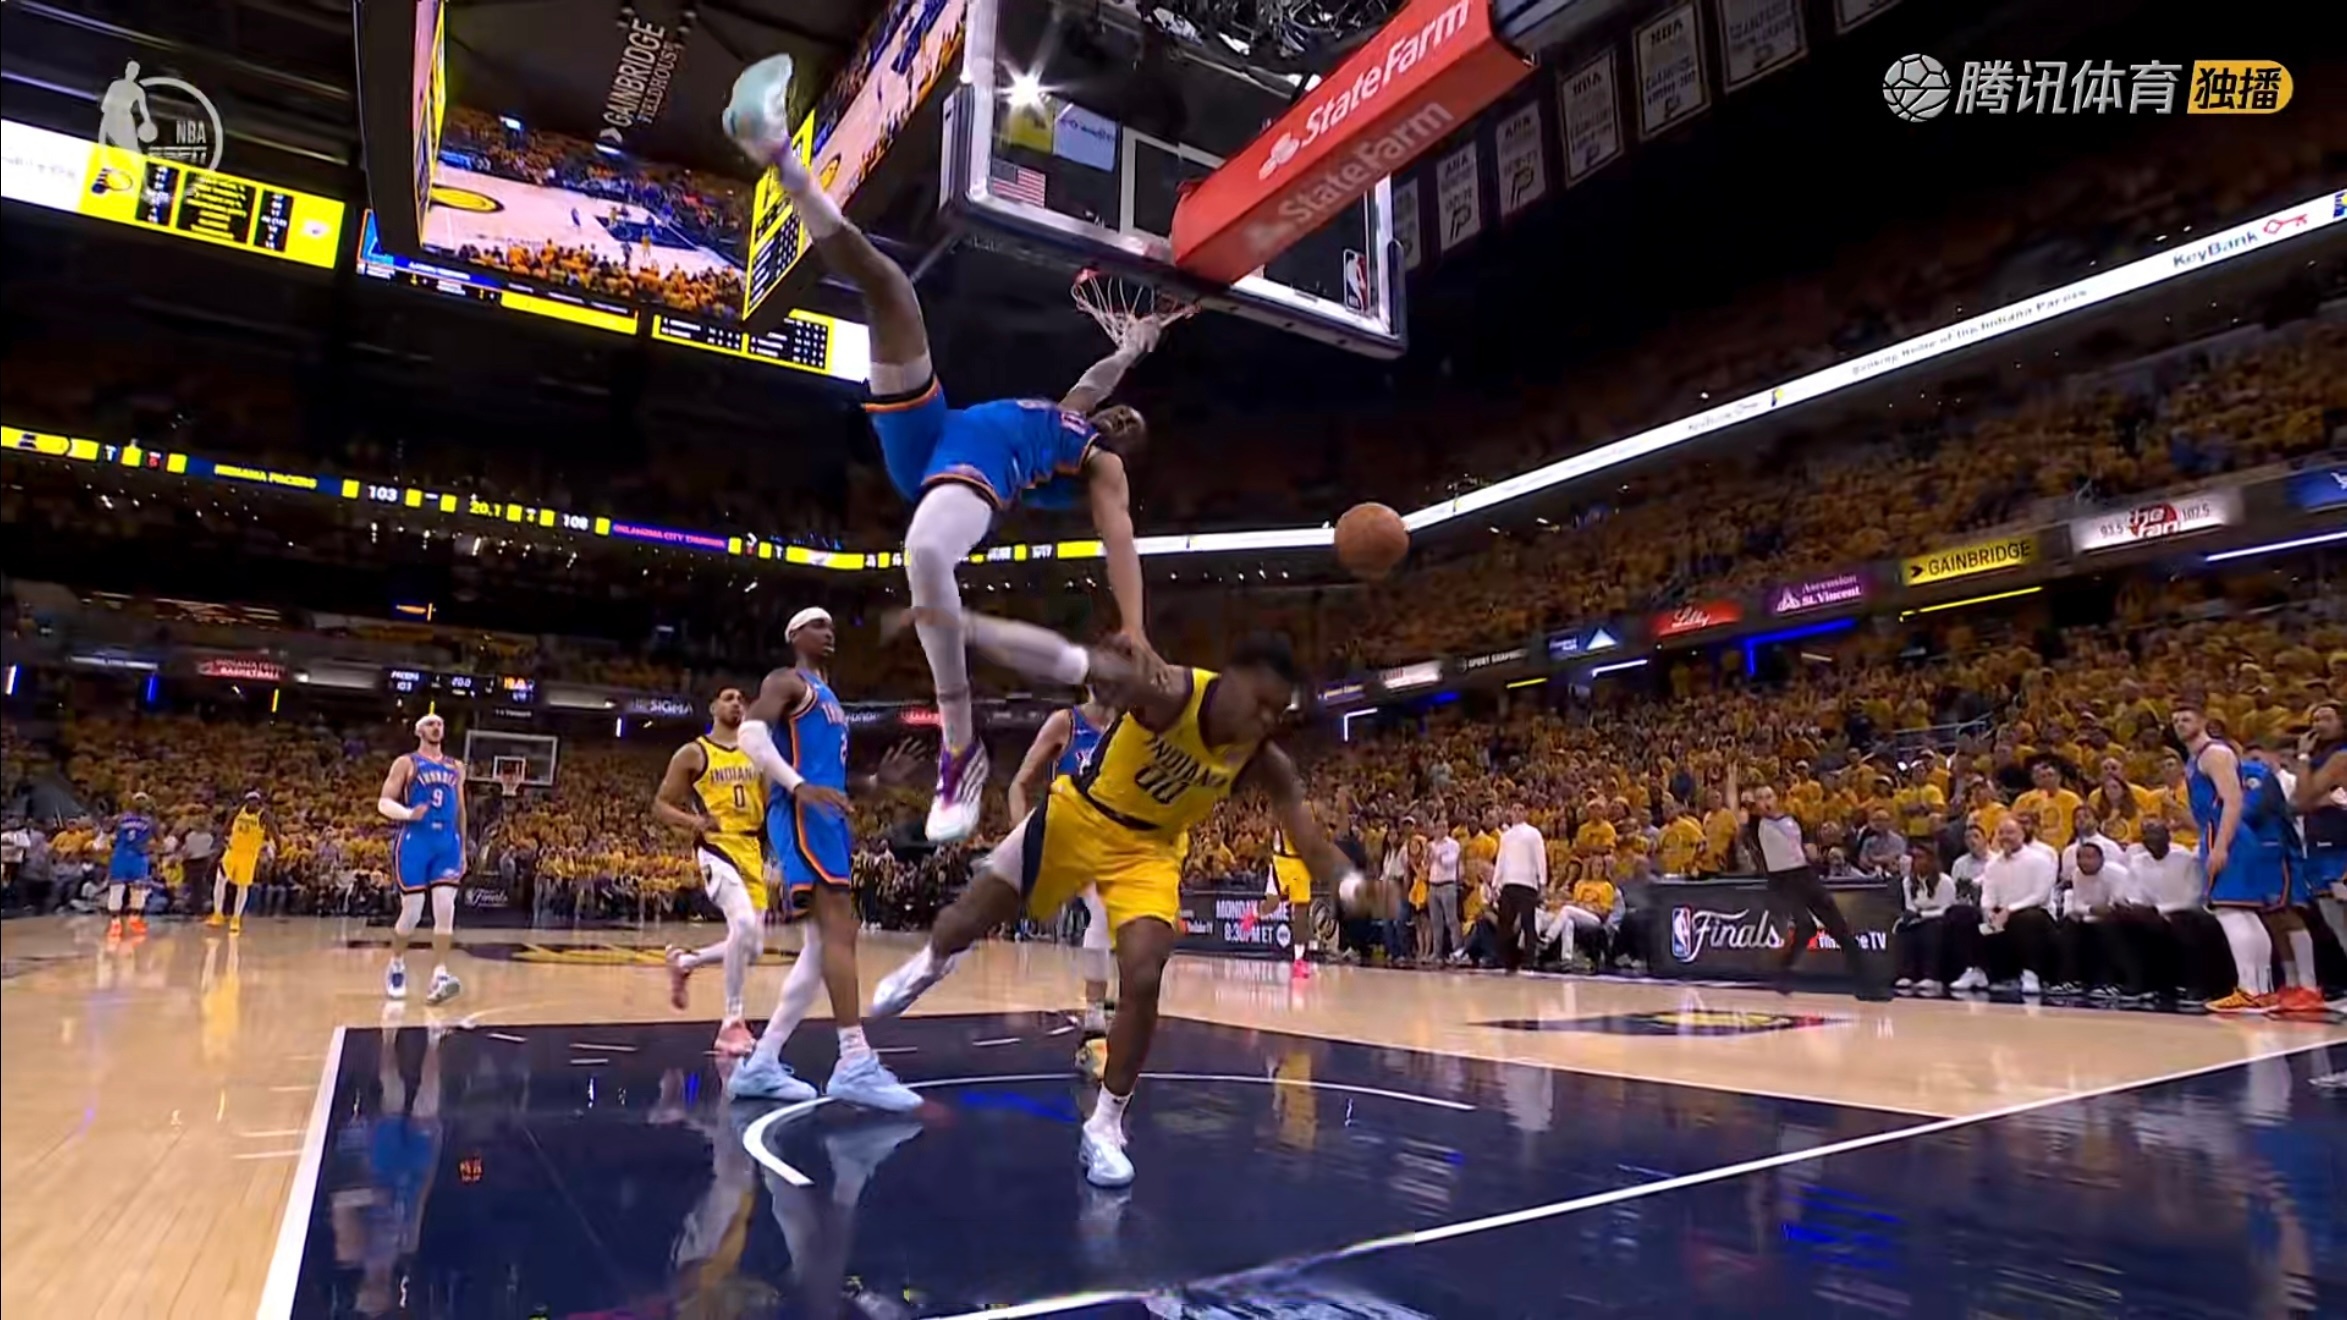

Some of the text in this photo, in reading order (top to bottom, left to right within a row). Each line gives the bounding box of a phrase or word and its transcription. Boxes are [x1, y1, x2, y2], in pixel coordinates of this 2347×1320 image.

[602, 17, 665, 128] GAINBRIDGE
[2173, 231, 2258, 267] KeyBank
[368, 484, 398, 501] 103
[469, 500, 500, 518] 20.1
[563, 513, 588, 530] 108
[2100, 521, 2124, 539] 93.5
[663, 531, 685, 542] CITY
[1928, 542, 2032, 576] GAINBRIDGE
[1817, 585, 1861, 604] Vincent
[1671, 605, 1711, 628] Lilly
[650, 699, 694, 715] SIGMA
[1134, 765, 1192, 805] 00
[431, 788, 444, 809] 9
[733, 784, 746, 809] 0
[1261, 925, 1274, 944] ET
[1691, 907, 1785, 963] Finals
